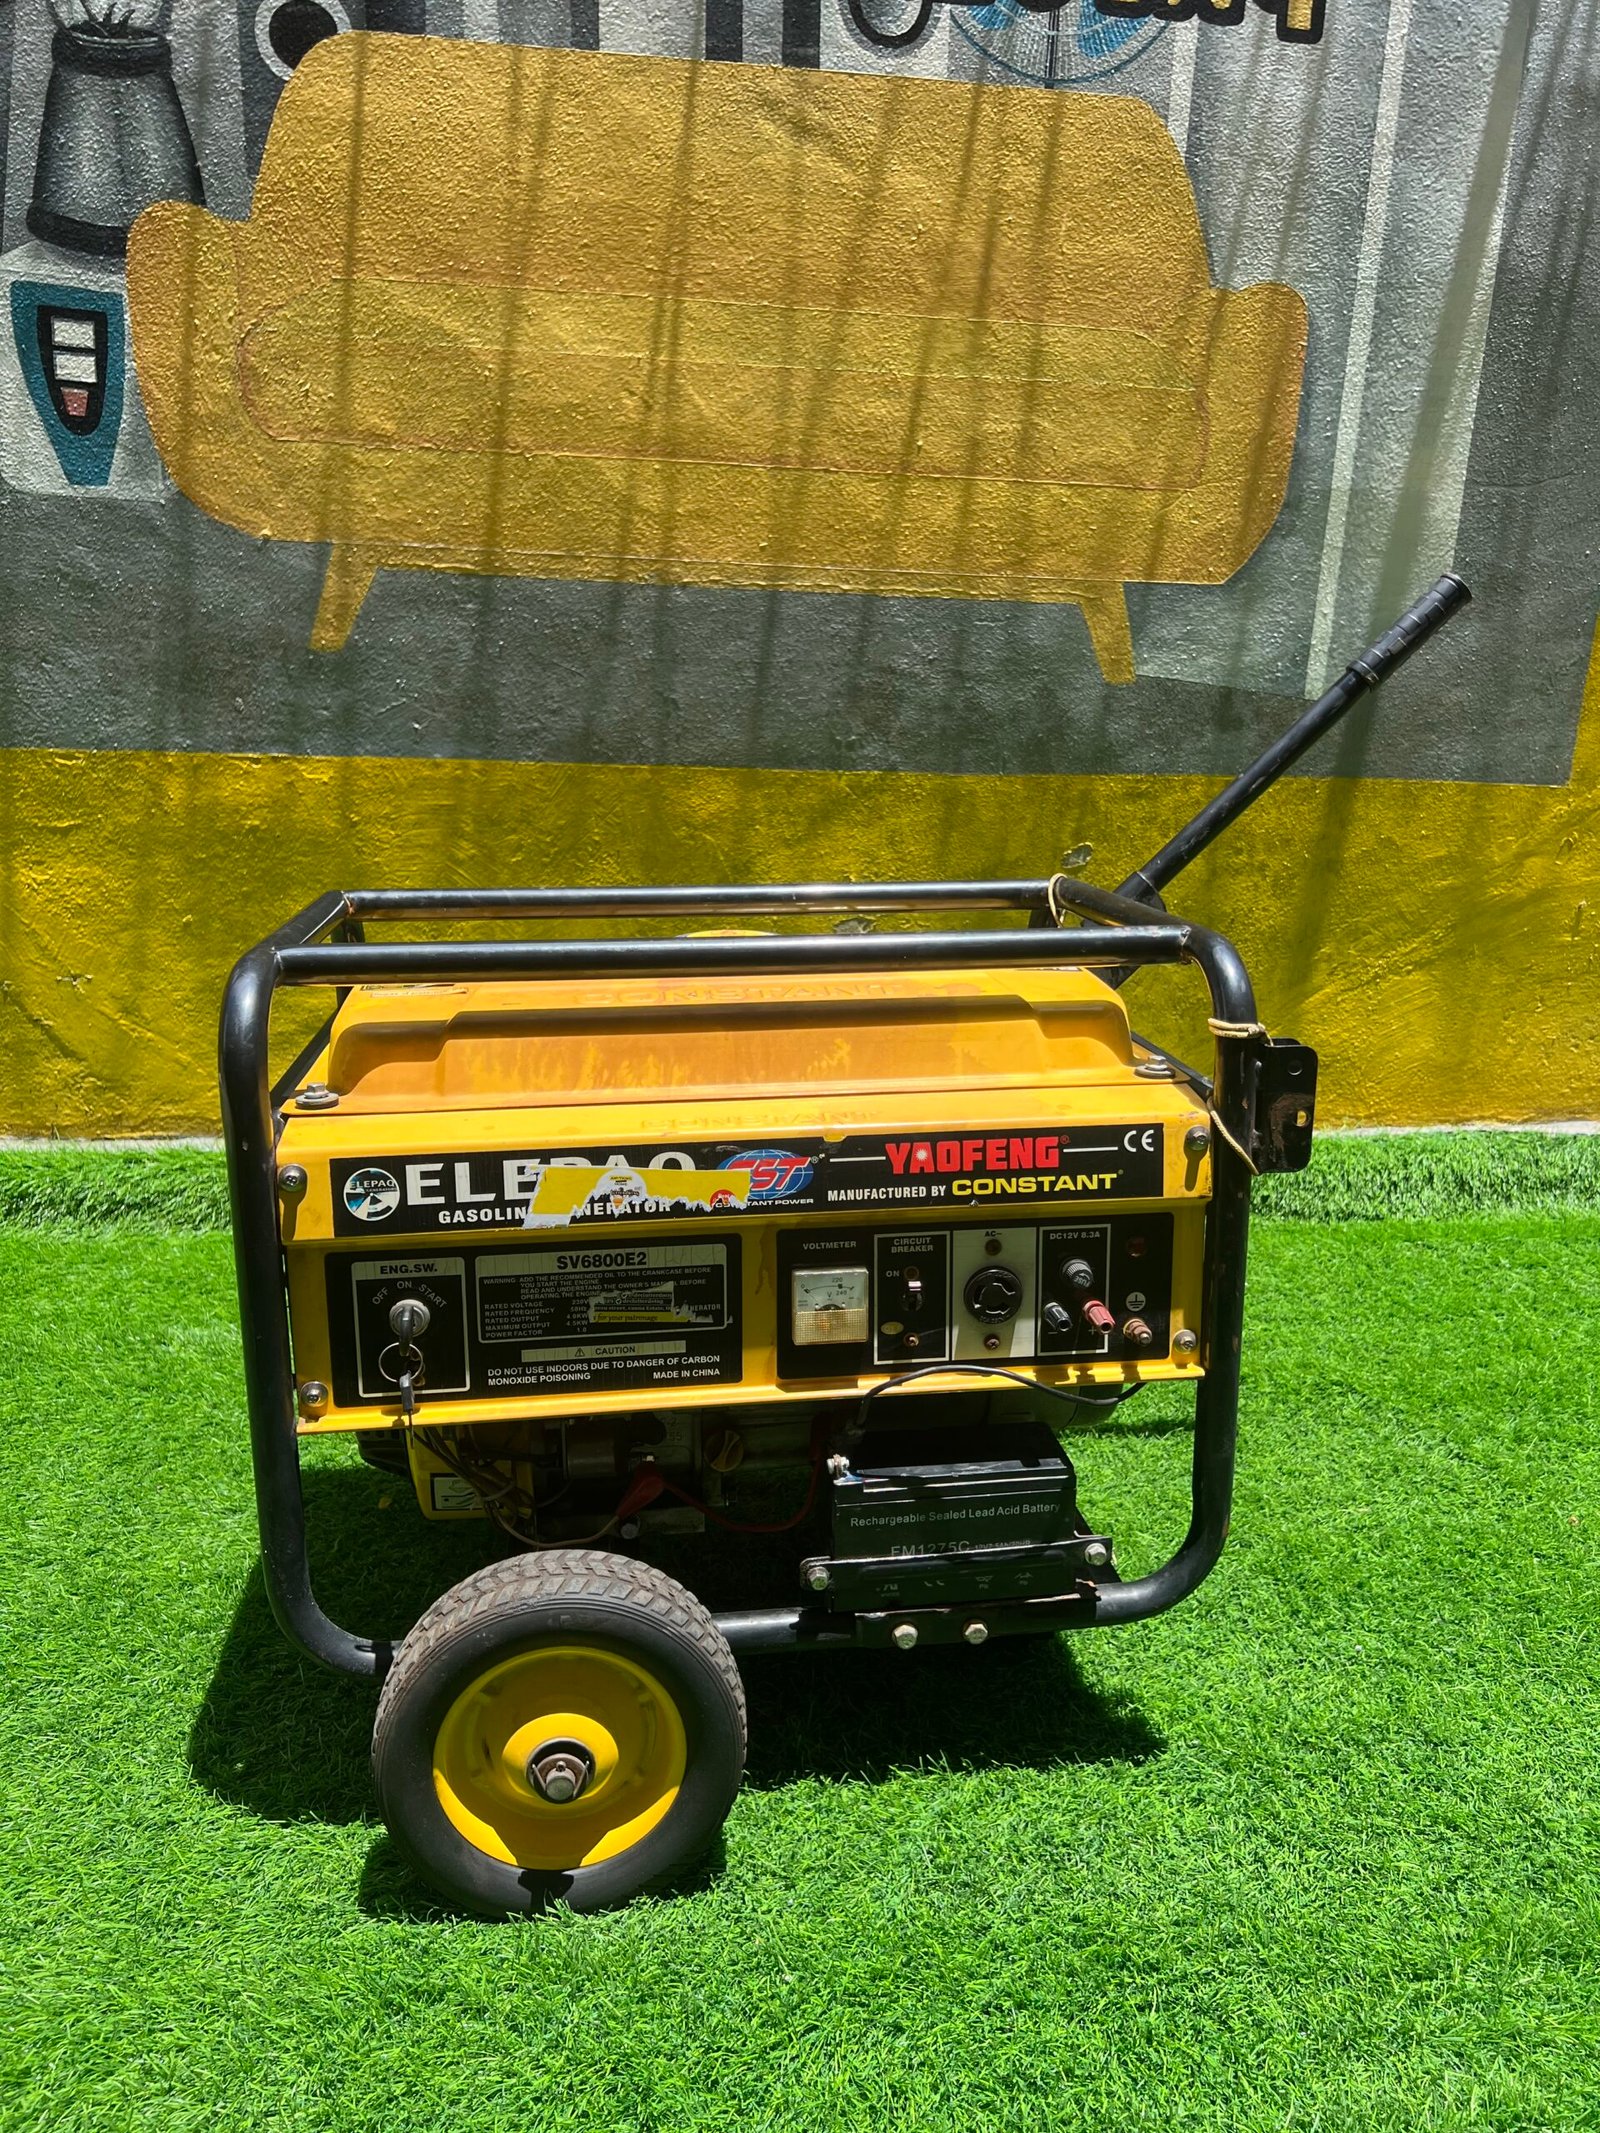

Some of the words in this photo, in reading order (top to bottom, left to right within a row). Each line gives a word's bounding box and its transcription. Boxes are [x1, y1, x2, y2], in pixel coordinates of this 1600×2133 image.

[1123, 1129, 1154, 1153] CE
[885, 1136, 1059, 1175] YAOFENG
[351, 1179, 395, 1188] ELEPAQ
[405, 1151, 696, 1206] ELE
[828, 1185, 927, 1202] MANUFACTURED
[930, 1184, 947, 1198] BY
[952, 1173, 1118, 1197] CONSTANT
[775, 1198, 814, 1206] POWER
[438, 1206, 527, 1224] GASOLIN
[582, 1199, 671, 1216] NERATOR
[1050, 1231, 1079, 1240] DC12V
[1081, 1231, 1100, 1239] 8.3A
[803, 1240, 857, 1250] VOLTMETER
[893, 1237, 932, 1246] CIRCUIT
[891, 1245, 934, 1253] BREAKER
[557, 1252, 647, 1270] SV6800E2
[380, 1263, 438, 1275] ENG.SW.
[886, 1270, 900, 1278] ON
[550, 1272, 603, 1281] RECOMMENDED
[396, 1280, 412, 1289] ON
[557, 1285, 602, 1293] UNDERSTAND
[372, 1287, 389, 1305] OFF
[418, 1284, 448, 1308] START
[511, 1308, 556, 1316] FREQUENCY
[512, 1315, 540, 1323] OUTPUT
[595, 1345, 636, 1356] CAUTION
[488, 1368, 502, 1376] DO
[504, 1367, 522, 1376] NOT
[525, 1365, 544, 1374] USE
[546, 1362, 588, 1373] INDOORS
[590, 1361, 610, 1370] DUE
[612, 1360, 624, 1369] TO
[626, 1358, 665, 1368] DANGER
[667, 1356, 680, 1366] OF
[681, 1354, 721, 1365] CARBON
[488, 1375, 538, 1386] MONOXIDE
[539, 1372, 591, 1383] POISONING
[653, 1370, 679, 1380] MADE
[681, 1369, 690, 1378] IN
[692, 1368, 721, 1378] CHINA
[850, 1511, 926, 1528] Rechargeable
[928, 1508, 966, 1521] Sealed
[968, 1506, 995, 1519] Lead
[997, 1503, 1020, 1516] Acid
[1022, 1502, 1061, 1516] Battery
